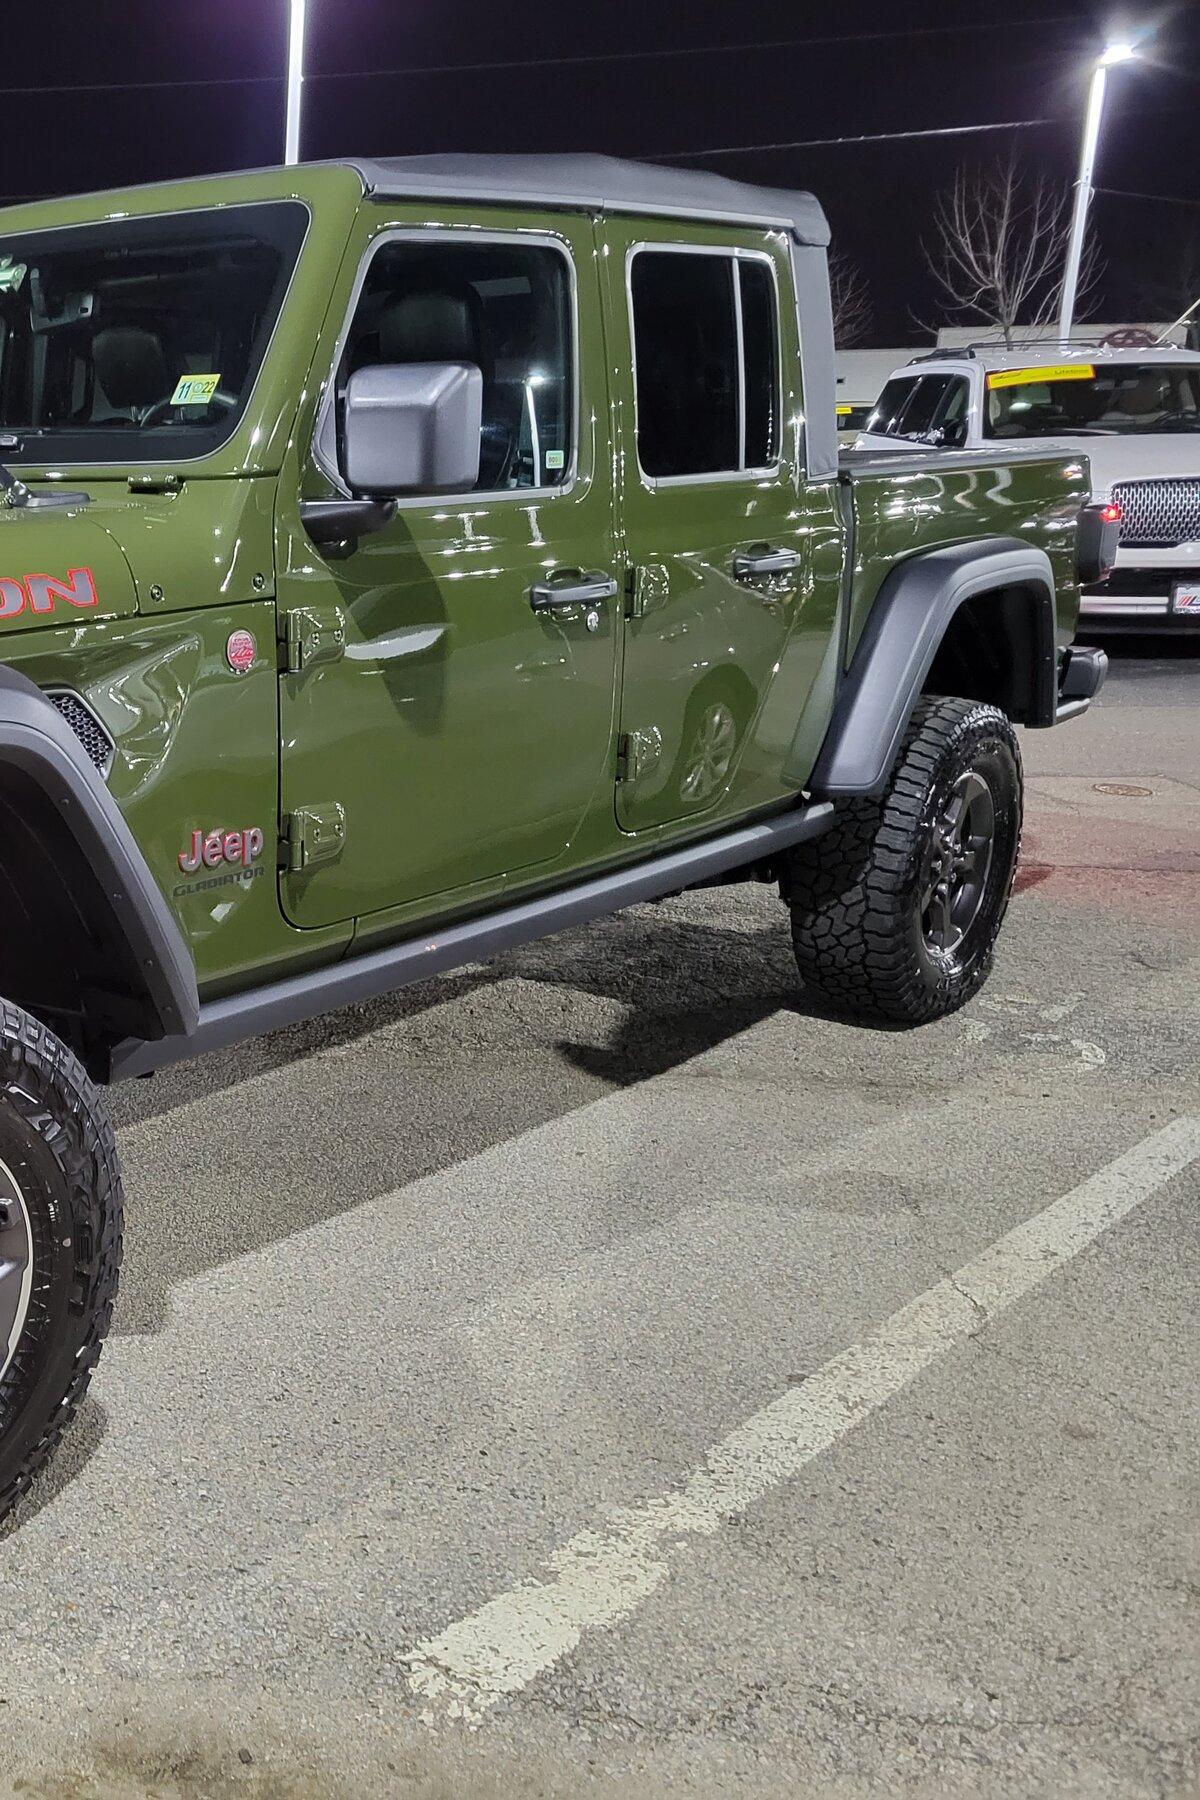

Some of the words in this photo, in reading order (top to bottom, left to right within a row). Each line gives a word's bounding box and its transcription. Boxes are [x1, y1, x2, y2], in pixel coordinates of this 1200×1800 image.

[178, 382, 192, 399] 11
[201, 381, 215, 394] 22
[178, 826, 264, 873] Jeep
[172, 866, 265, 898] GLADIATOR
